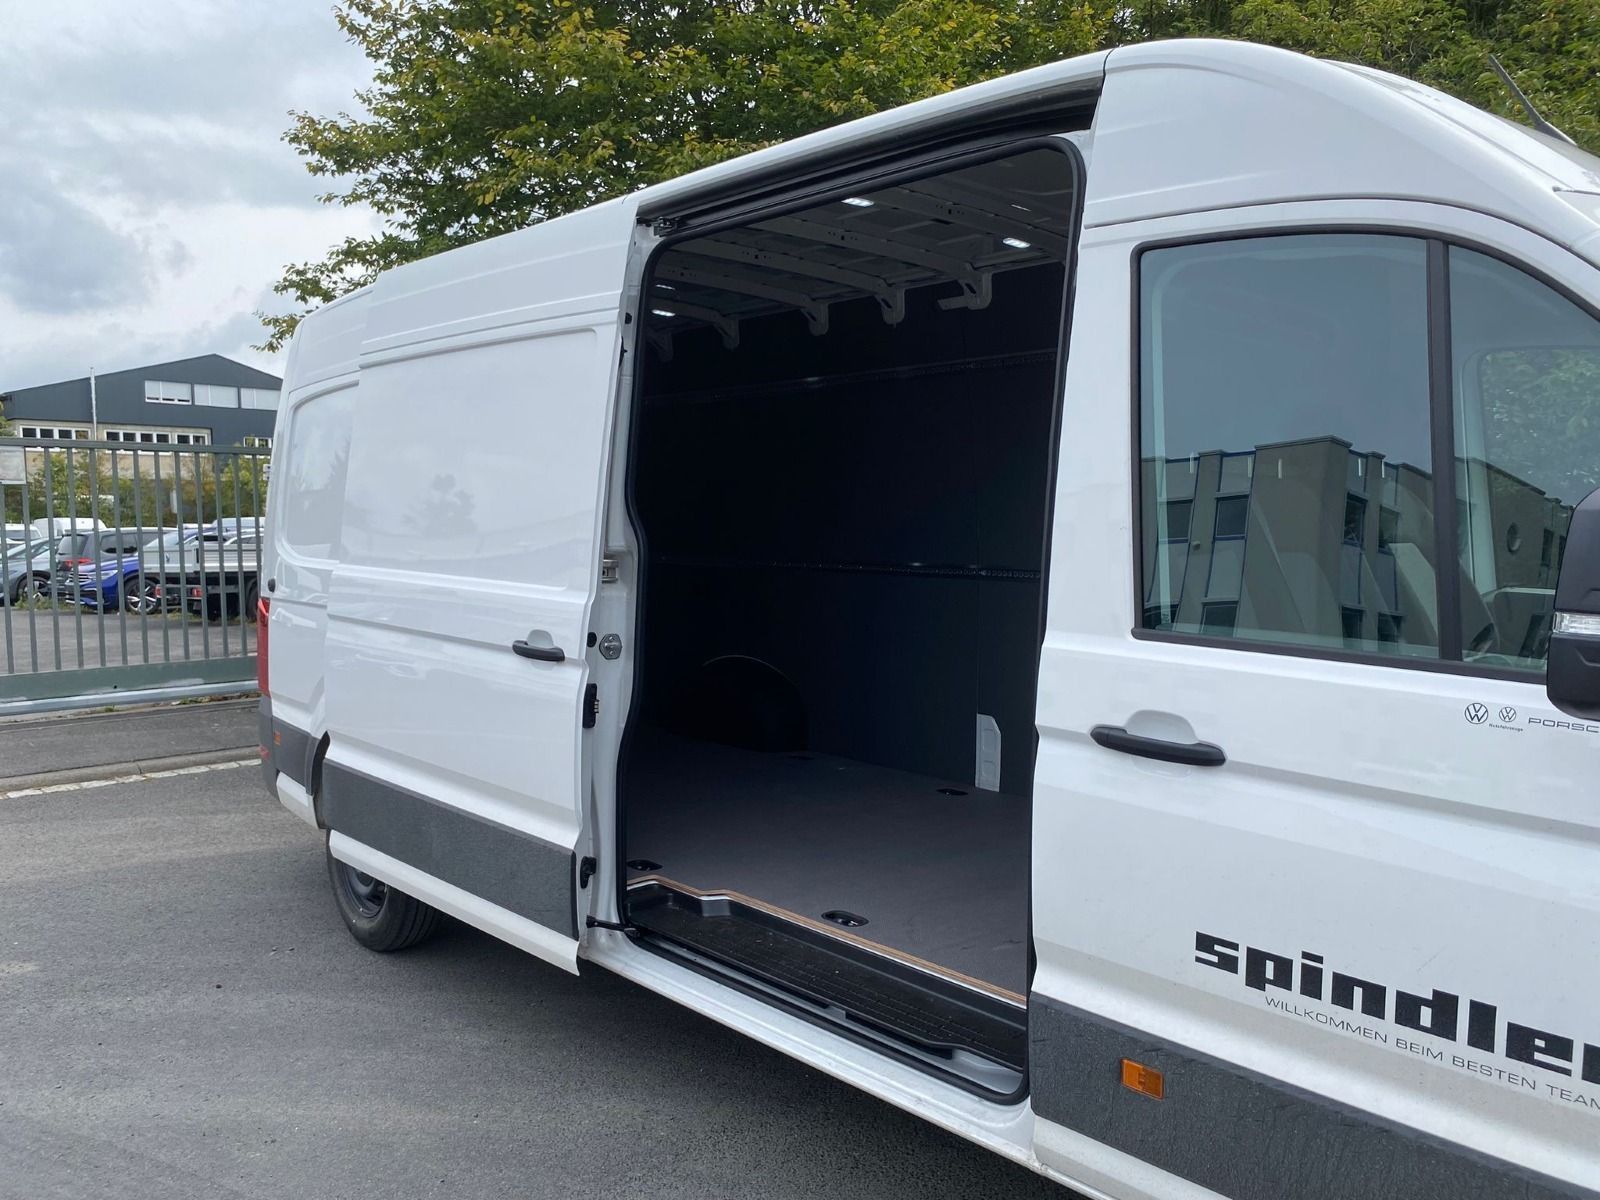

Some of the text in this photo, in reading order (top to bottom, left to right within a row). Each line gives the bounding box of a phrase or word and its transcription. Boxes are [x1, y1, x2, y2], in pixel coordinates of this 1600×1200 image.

[1265, 996, 1387, 1044] WILLKOMMEN
[1395, 1037, 1443, 1062] BEIM
[1452, 1055, 1536, 1091] BESTEN
